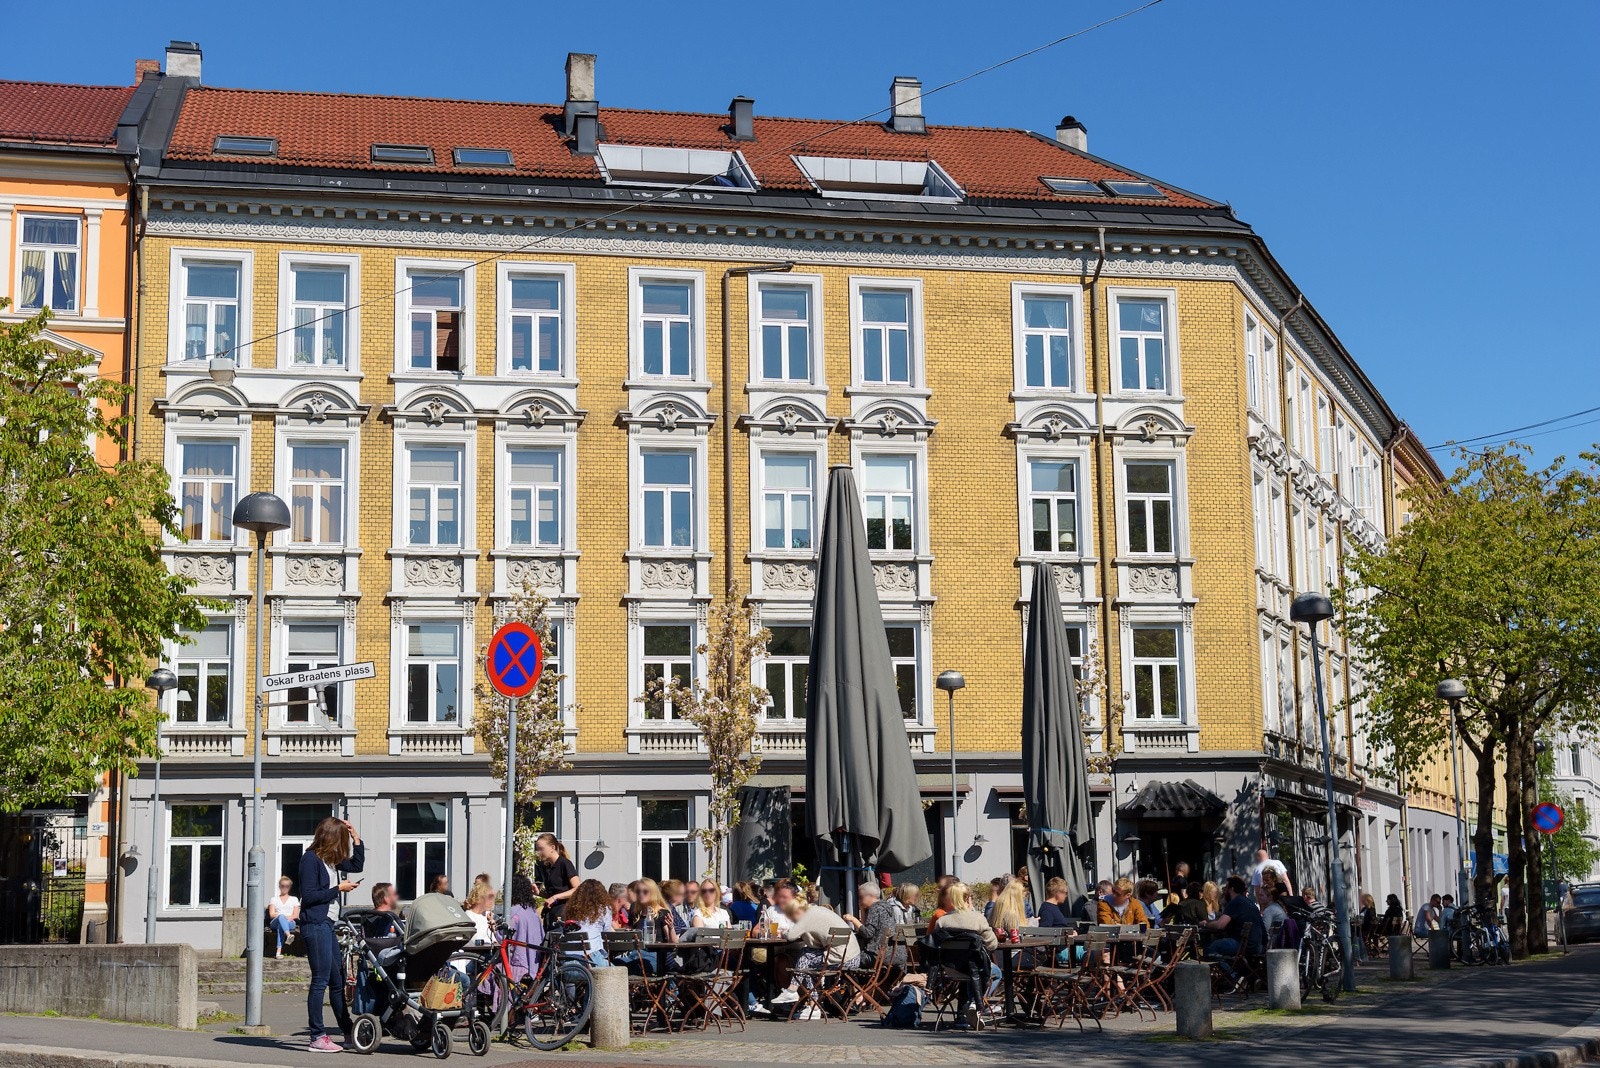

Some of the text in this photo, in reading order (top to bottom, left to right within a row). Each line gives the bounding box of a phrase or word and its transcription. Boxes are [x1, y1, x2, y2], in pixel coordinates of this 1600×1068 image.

[266, 666, 370, 687] Oskar Braatens plass
